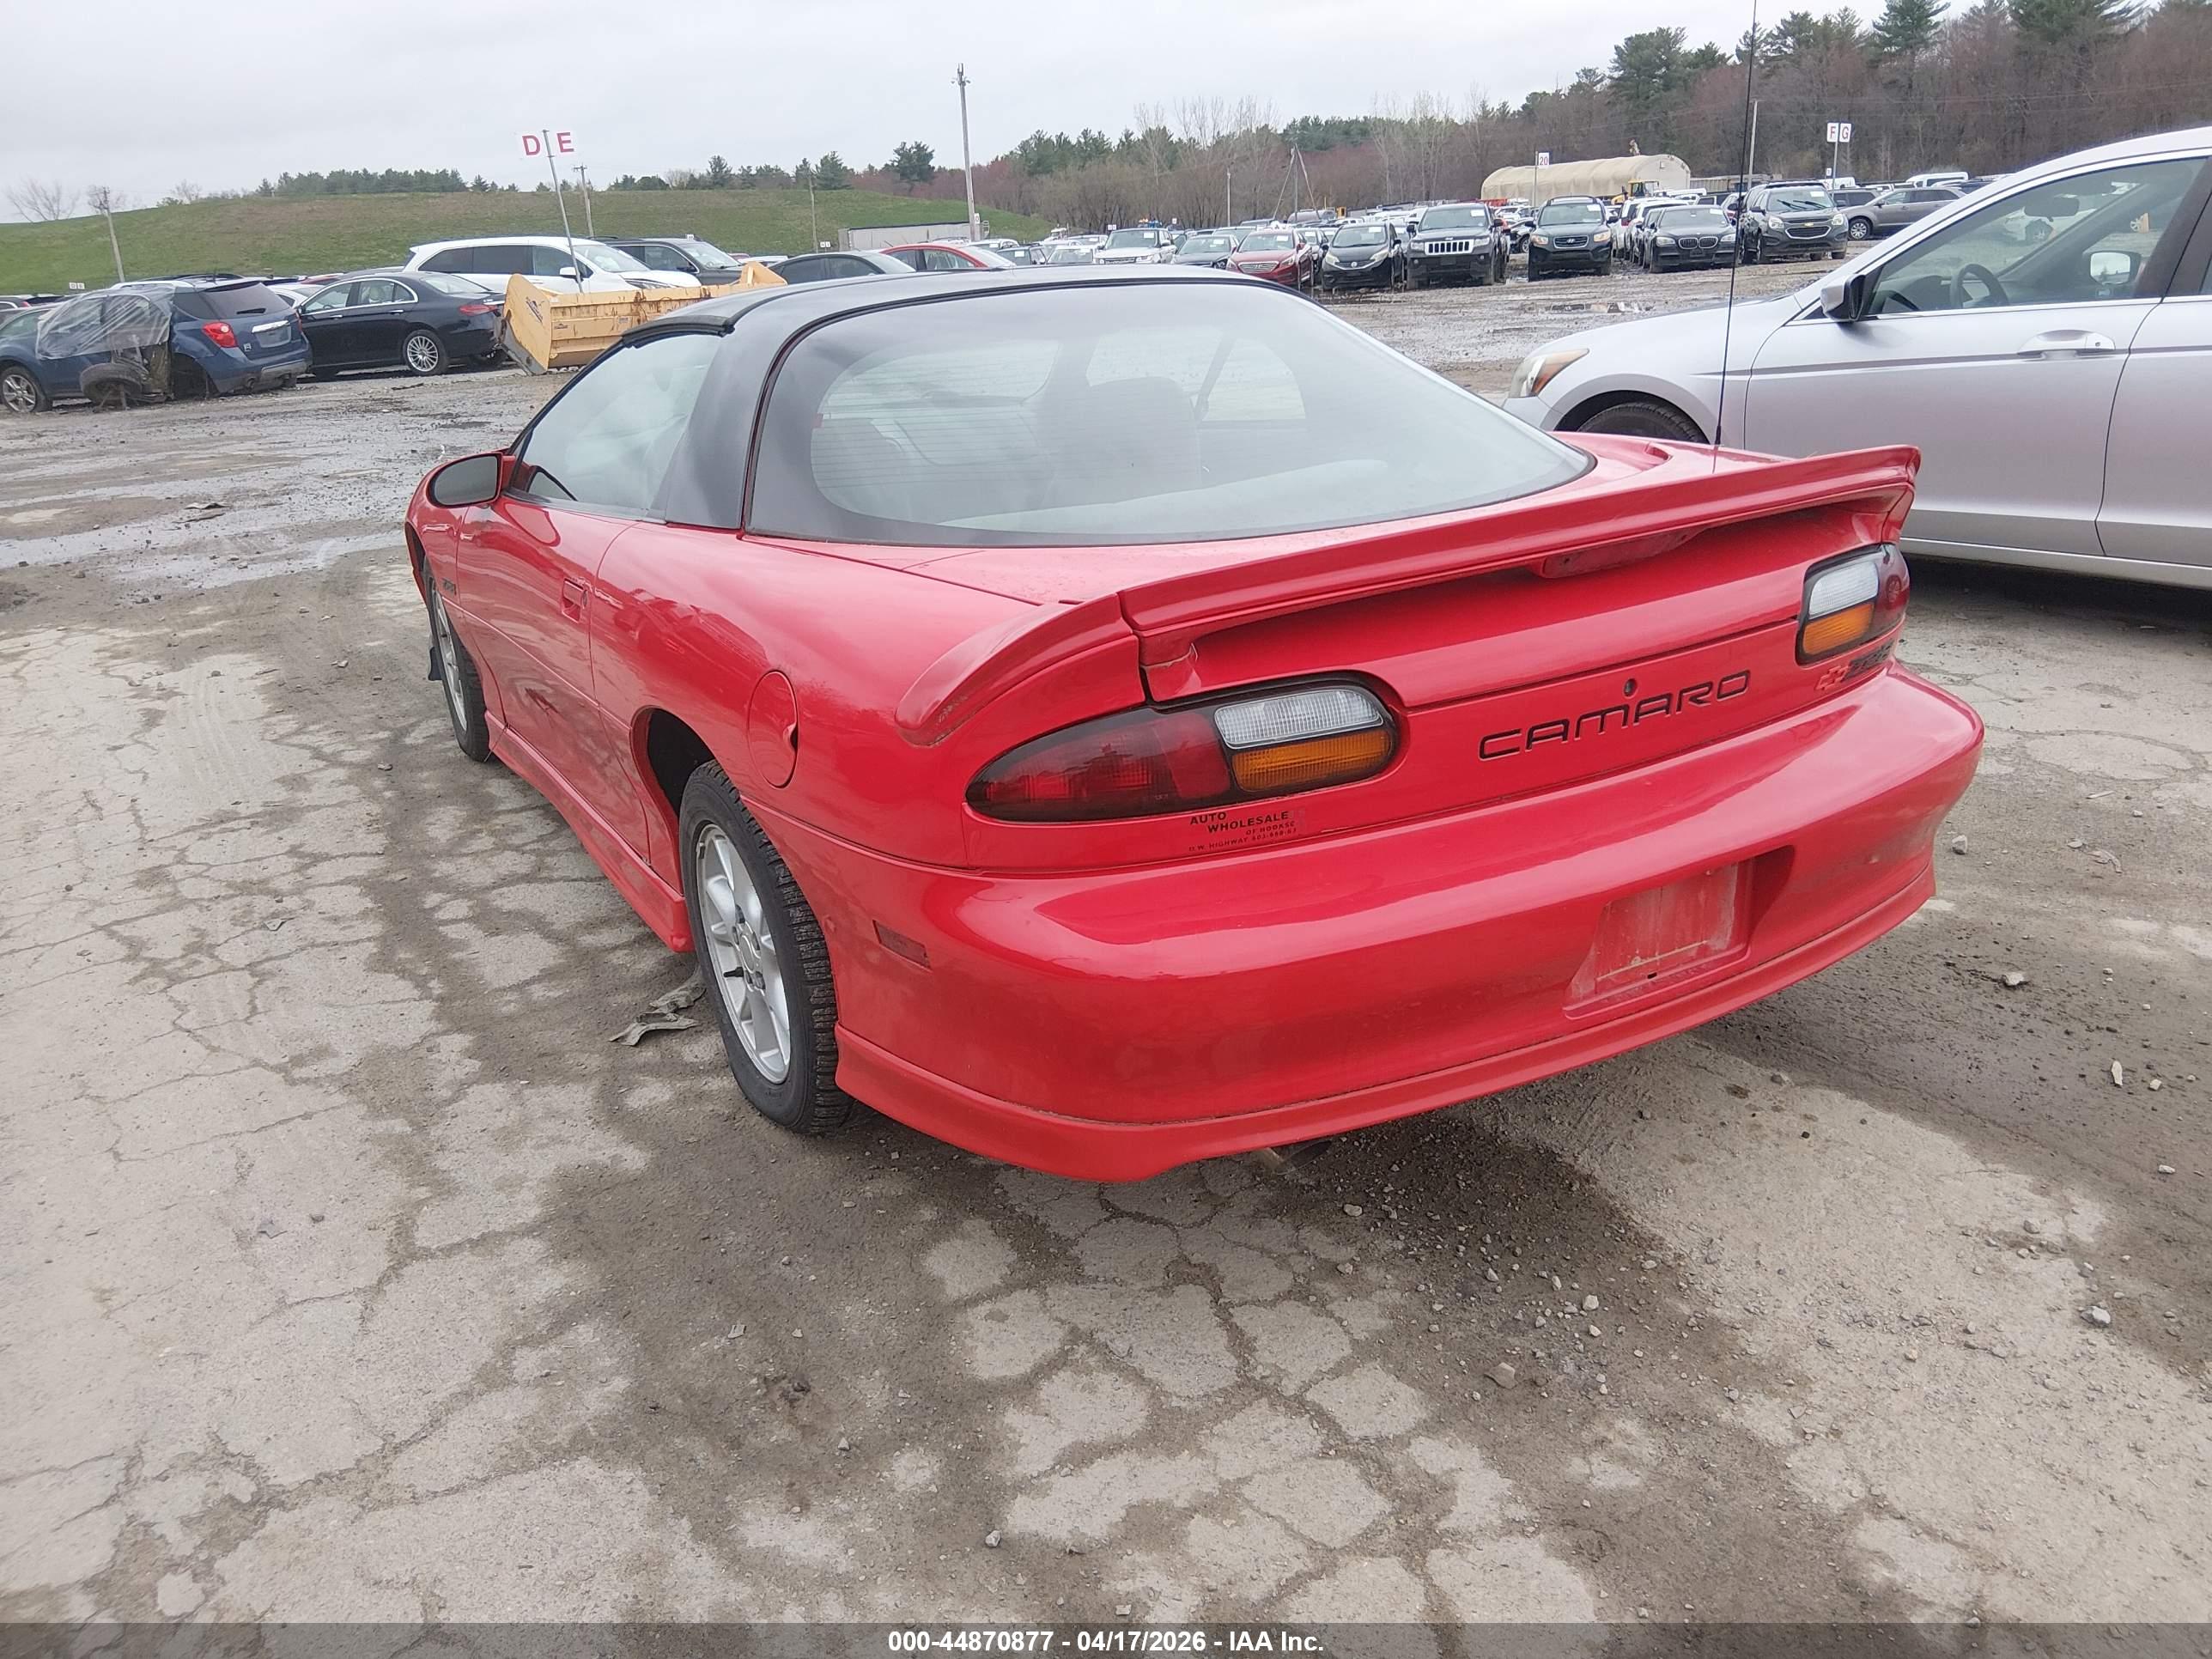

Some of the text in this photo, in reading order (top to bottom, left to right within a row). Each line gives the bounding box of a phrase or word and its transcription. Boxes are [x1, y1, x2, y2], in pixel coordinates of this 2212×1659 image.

[1830, 125, 1849, 139] F G
[522, 131, 574, 155] D E
[1539, 156, 1548, 166] 20
[1479, 671, 1750, 760] CAMARO
[1190, 811, 1226, 825] AUTO
[1208, 811, 1289, 834] WHOLESALE
